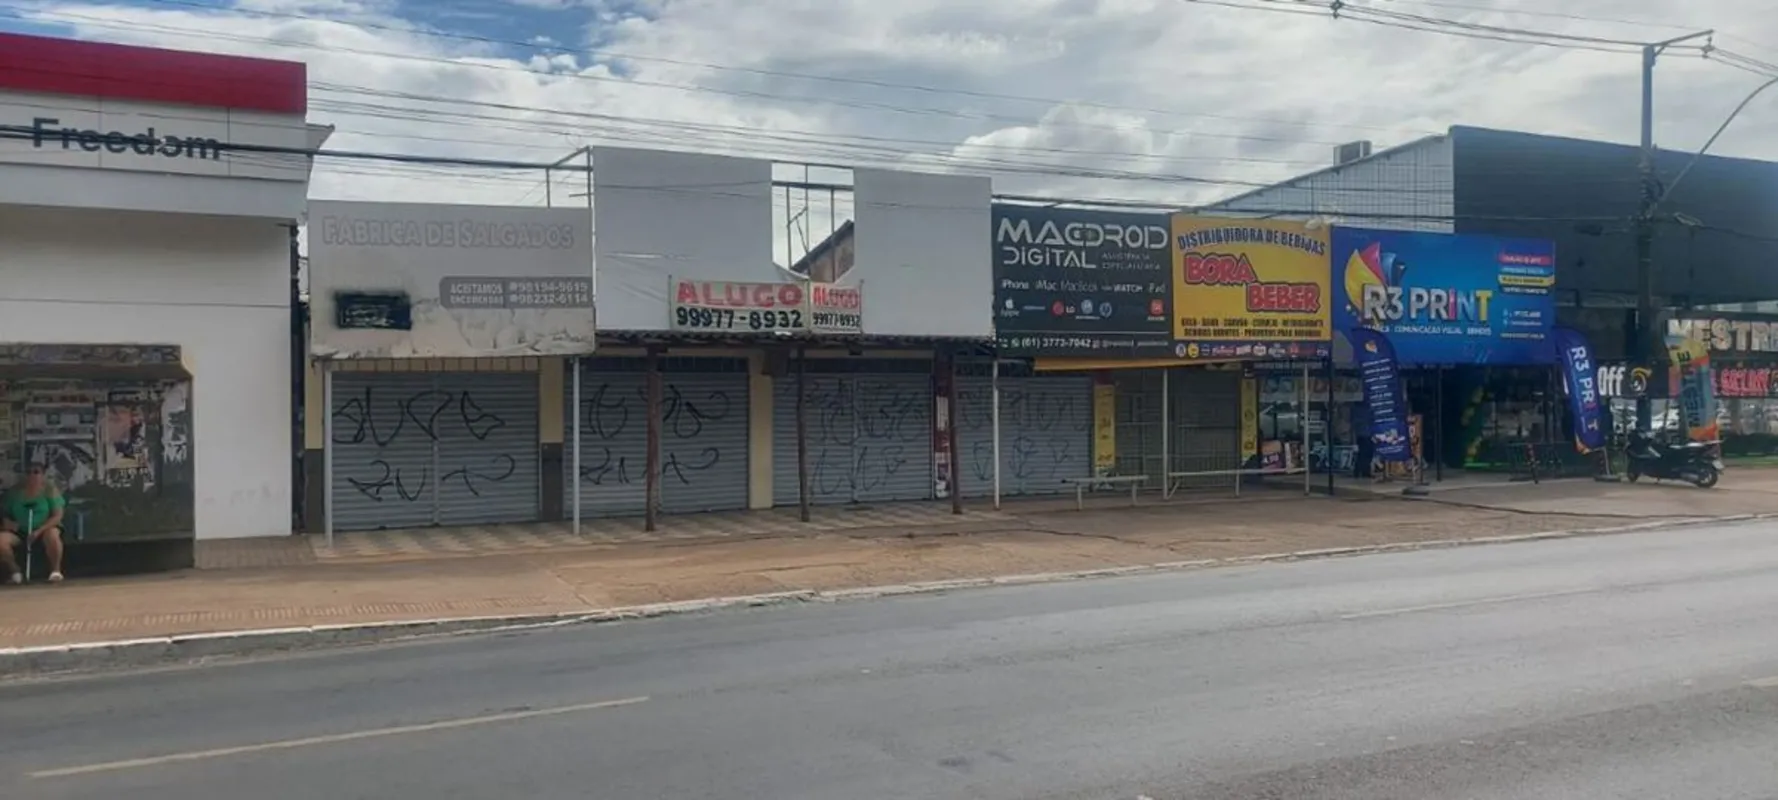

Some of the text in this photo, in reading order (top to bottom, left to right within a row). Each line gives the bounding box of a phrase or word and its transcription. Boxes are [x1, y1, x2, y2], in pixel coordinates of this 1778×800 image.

[33, 117, 220, 160] Freedom
[426, 221, 455, 247] DE
[459, 219, 575, 249] SALGADOS
[1177, 227, 1326, 256] DISTRIBUIDORA DE BEBIDAS
[1185, 252, 1258, 285] BORA
[676, 281, 803, 308] ALUGO
[813, 284, 860, 309] ALUGO
[1246, 282, 1322, 313] BEBER
[1363, 283, 1493, 321] R3 PRINT
[676, 307, 804, 330] 99977-8932
[1021, 336, 1041, 349] (61)
[1570, 346, 1590, 372] R3
